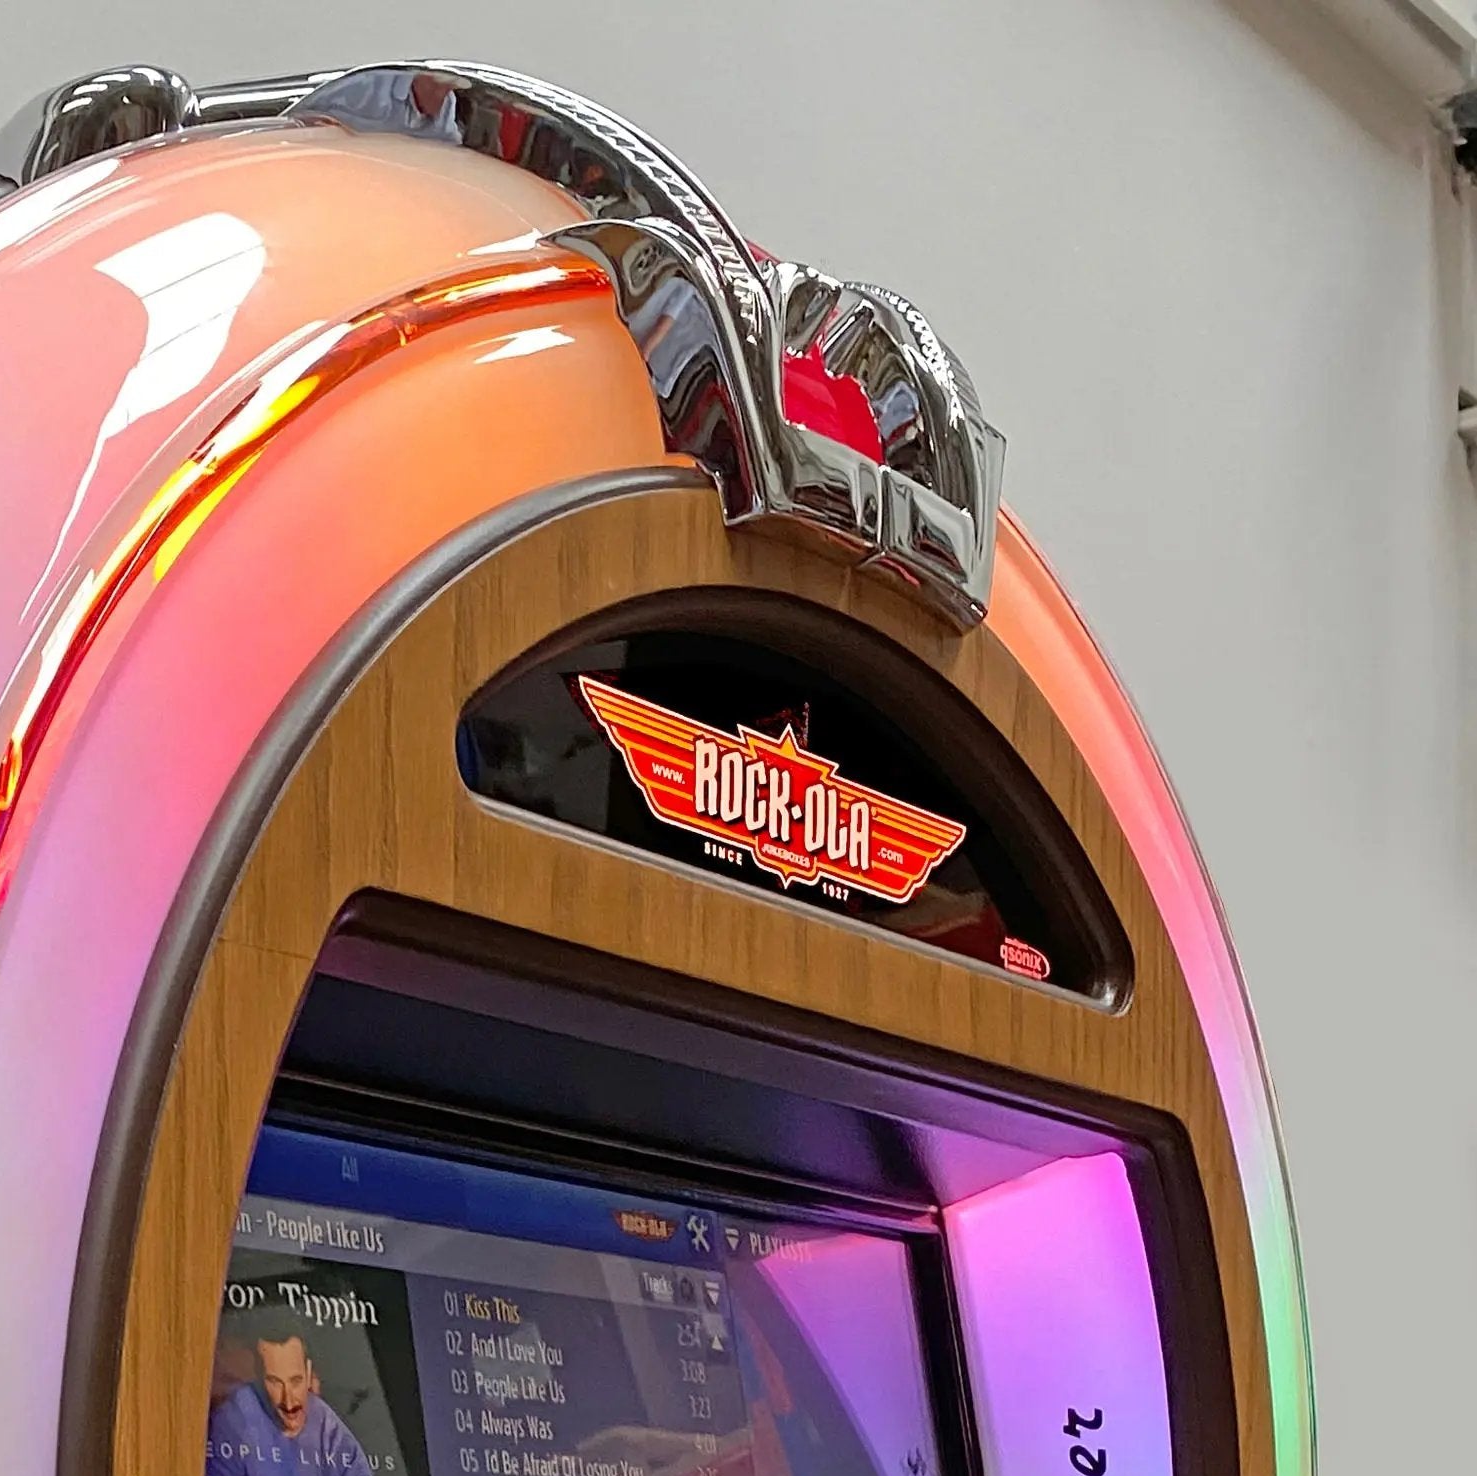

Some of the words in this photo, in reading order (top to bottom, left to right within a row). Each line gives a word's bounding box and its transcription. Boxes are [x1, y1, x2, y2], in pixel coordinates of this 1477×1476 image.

[704, 841, 743, 866] SINCE
[822, 882, 849, 902] 1927
[266, 1210, 324, 1251] People
[327, 1220, 360, 1251] Like
[362, 1226, 385, 1253] Us
[278, 1281, 380, 1328] Tippin
[443, 1289, 460, 1317] 01
[464, 1293, 491, 1319] Kiss
[493, 1296, 521, 1324] This
[445, 1330, 464, 1356] 02
[471, 1332, 496, 1360] And
[506, 1338, 535, 1364] Love
[537, 1340, 563, 1366] You
[451, 1369, 469, 1395] 03
[475, 1371, 519, 1406] People
[521, 1377, 547, 1402] Like
[548, 1380, 565, 1404] Us
[455, 1407, 473, 1433] 04
[481, 1410, 525, 1446] Always
[526, 1414, 554, 1441] Was
[299, 1449, 352, 1469] LIKE
[368, 1454, 396, 1471] US
[460, 1447, 479, 1472] 05
[502, 1451, 519, 1476] Be
